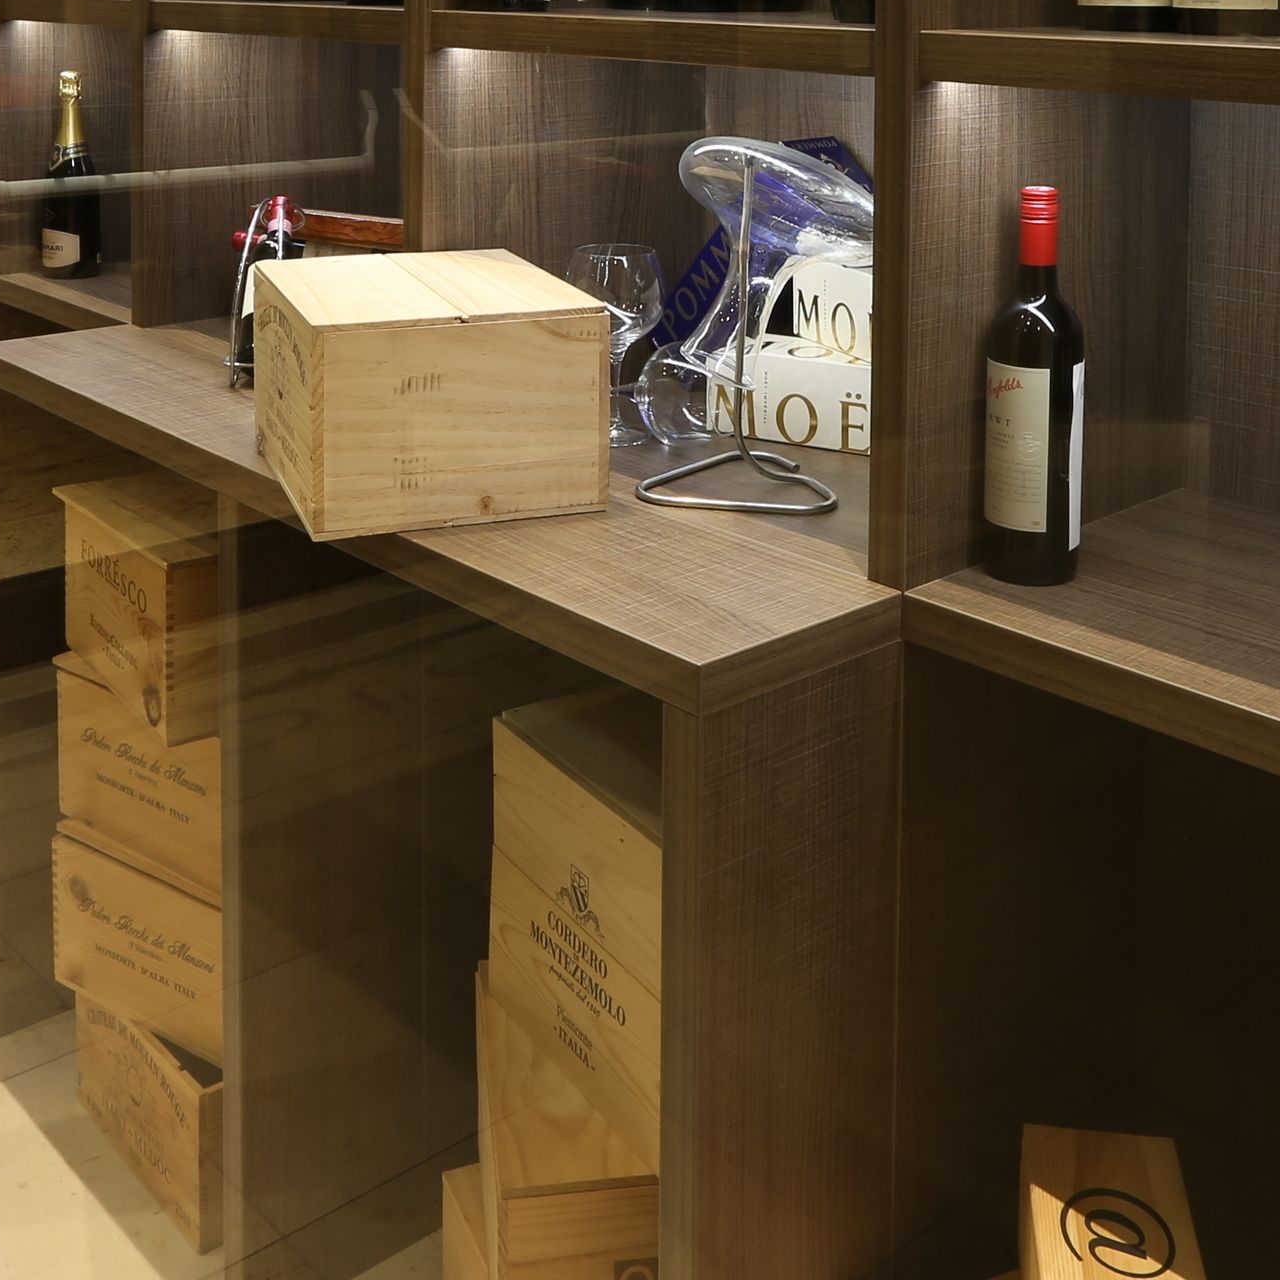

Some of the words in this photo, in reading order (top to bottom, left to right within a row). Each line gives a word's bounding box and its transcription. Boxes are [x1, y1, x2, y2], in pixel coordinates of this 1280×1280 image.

[797, 287, 873, 354] MO
[81, 727, 111, 753] Podere
[114, 742, 148, 769] Rocche
[148, 760, 161, 774] dei
[163, 764, 209, 797] Manzoni
[96, 773, 135, 798] MONFORTE
[79, 896, 111, 925] Podere
[114, 915, 149, 944] Rocche
[151, 934, 165, 949] dei
[167, 940, 216, 974] Manzoni
[547, 910, 608, 980] CORDERO
[95, 943, 136, 971] MONFORTE
[140, 966, 170, 987] D'ALBA
[174, 982, 198, 1000] ITALY
[530, 919, 626, 1027] MONTEZEMOLO
[556, 1004, 593, 1051] Piemonte
[159, 1077, 187, 1129] ROUGE
